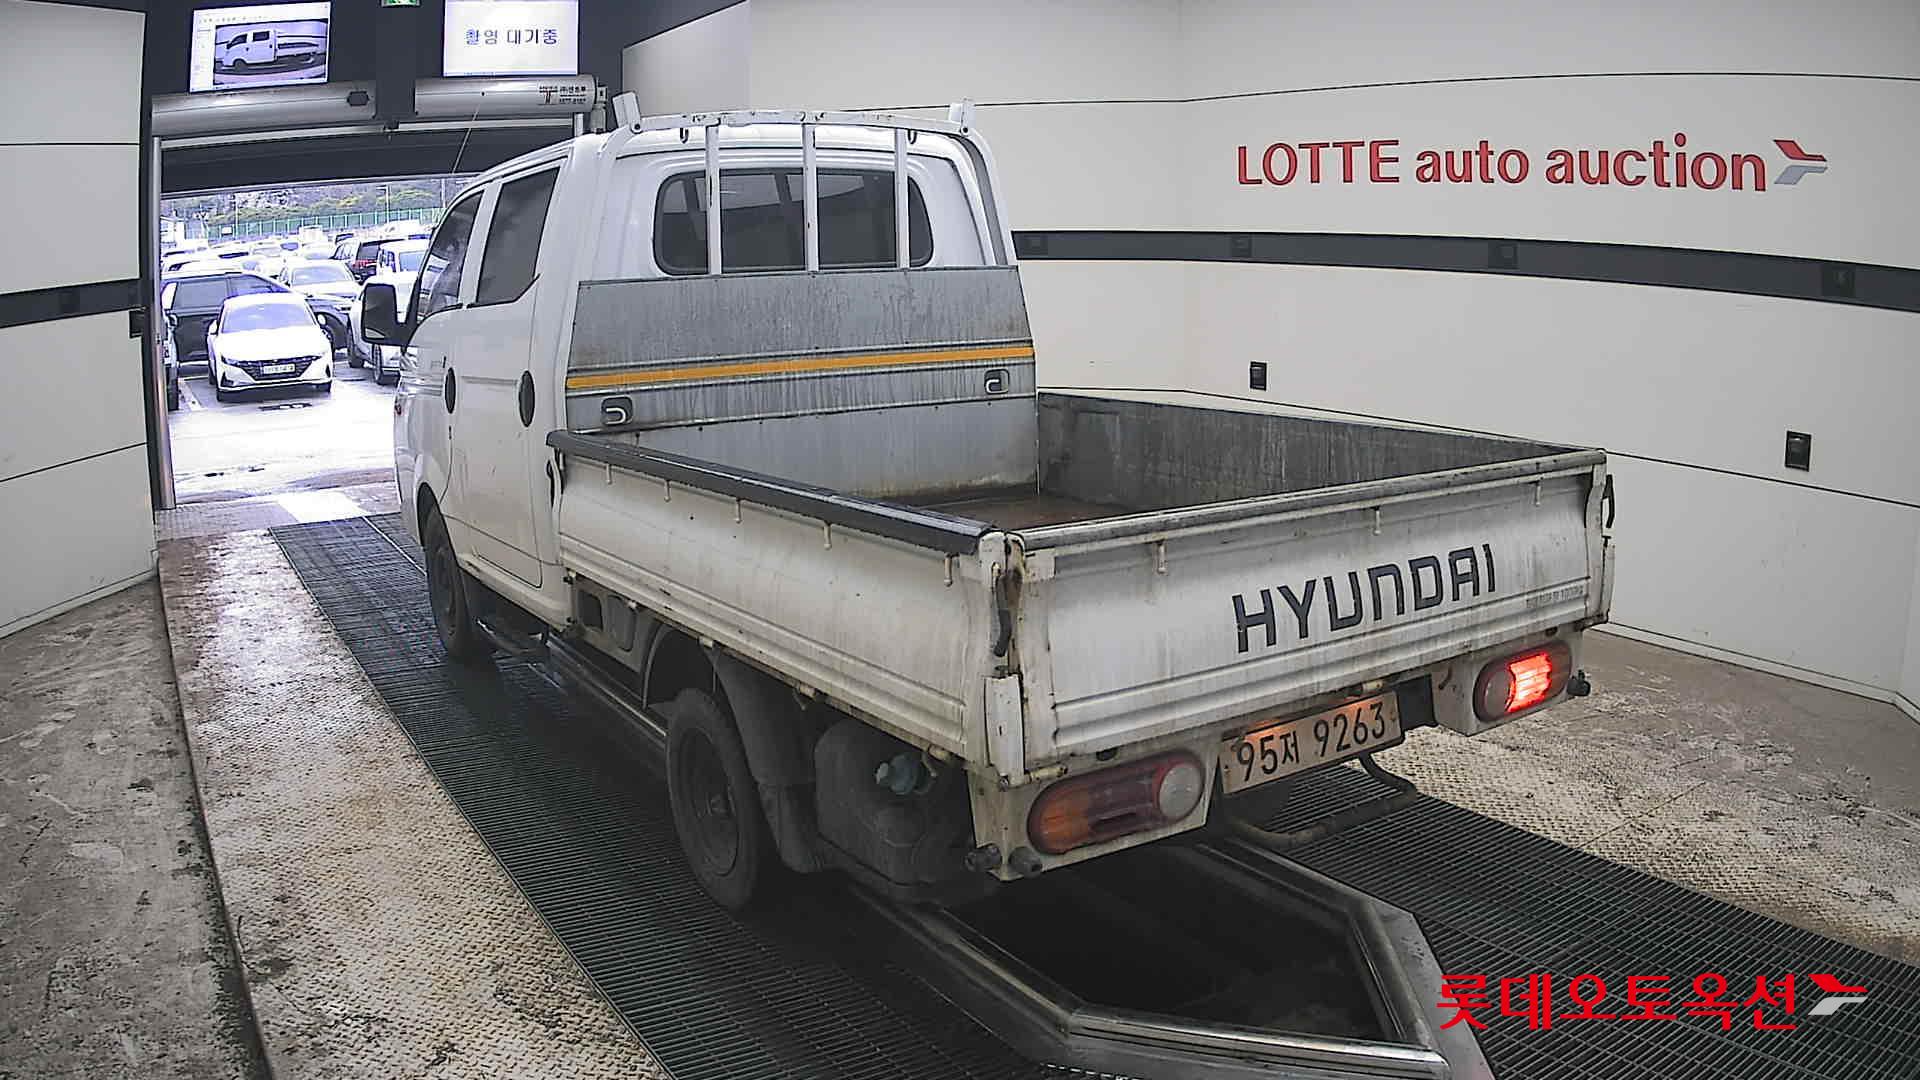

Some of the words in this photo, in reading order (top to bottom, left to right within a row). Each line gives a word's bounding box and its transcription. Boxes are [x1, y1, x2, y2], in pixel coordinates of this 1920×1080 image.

[507, 28, 558, 45] 대기중
[1238, 139, 1400, 185] LOTTE
[1415, 140, 1530, 184] auto
[1545, 133, 1767, 191] auction
[1232, 543, 1496, 653] HYUNDAI
[1237, 730, 1300, 782] 95저
[1313, 702, 1386, 757] 9263
